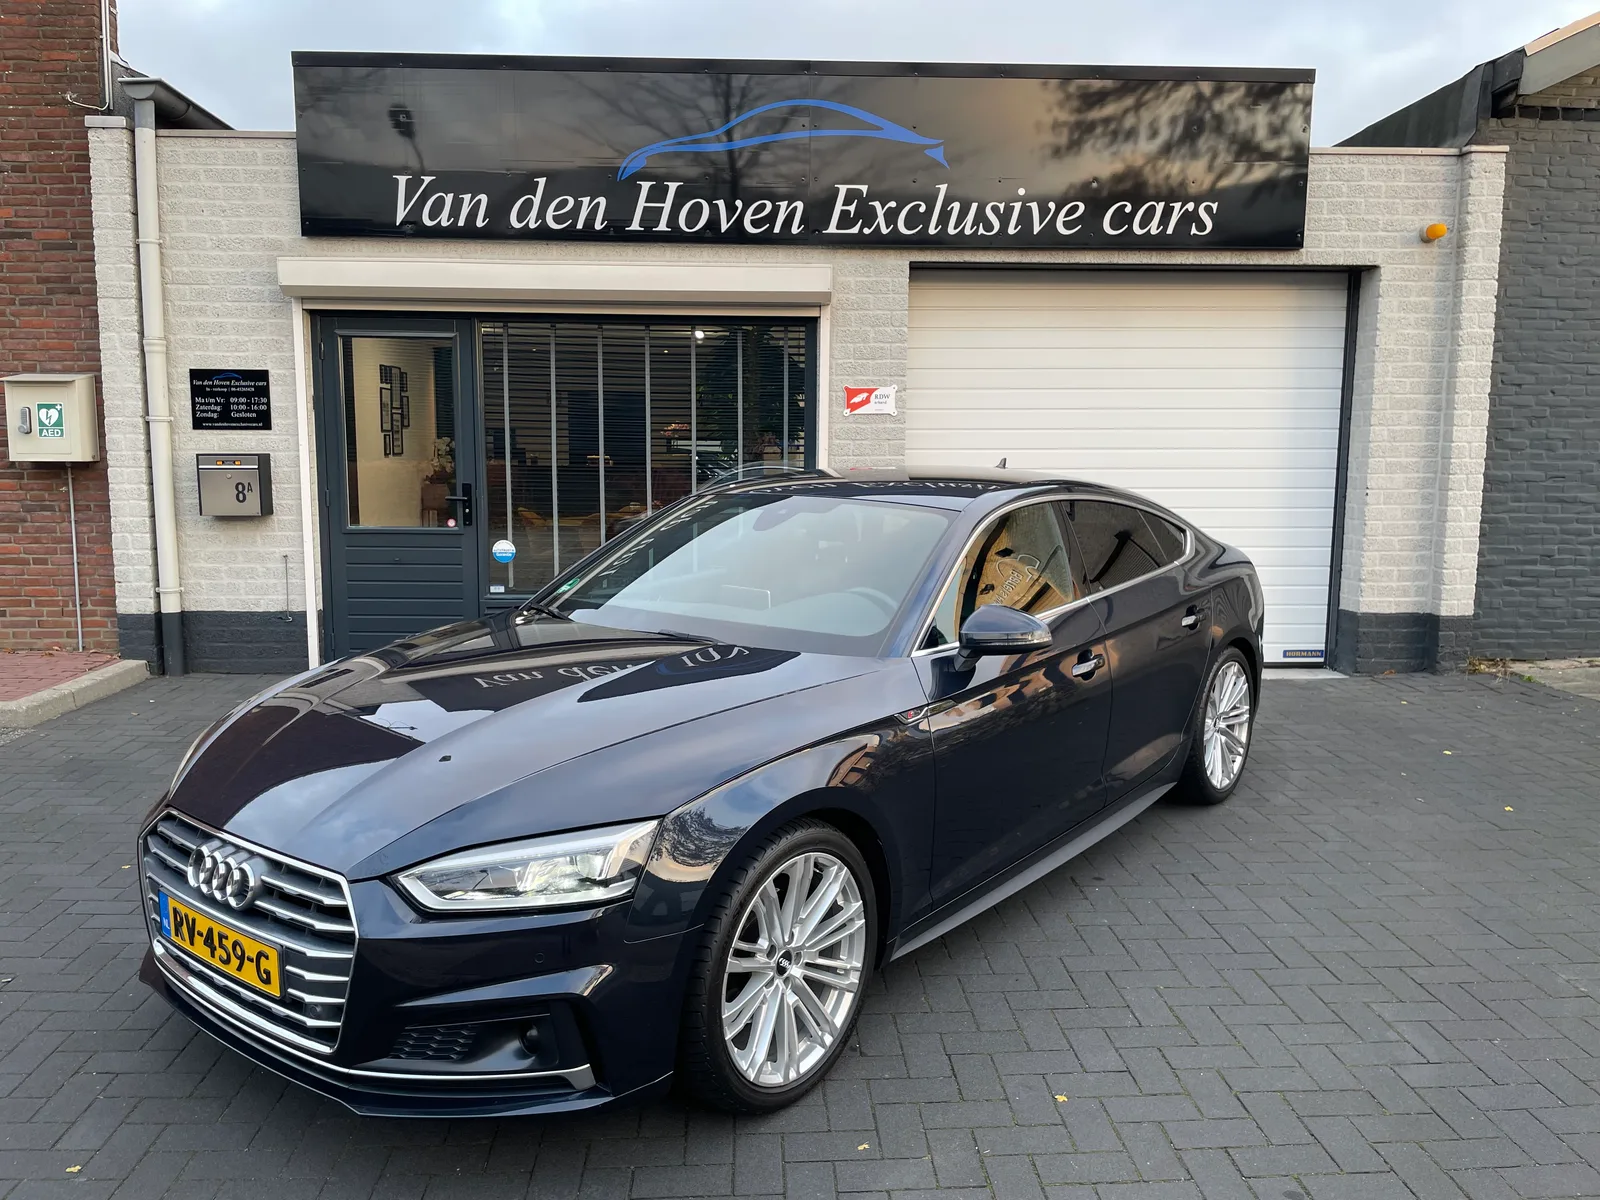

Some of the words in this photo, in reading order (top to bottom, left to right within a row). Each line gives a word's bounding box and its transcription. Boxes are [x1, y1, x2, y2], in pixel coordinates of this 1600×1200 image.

[392, 175, 489, 228] Van
[509, 177, 607, 230] den
[625, 181, 805, 235] Hoven
[823, 184, 1085, 236] Exclusive
[1103, 200, 1219, 236] cars
[195, 404, 223, 412] Zaterdag:
[42, 429, 61, 437] AED
[163, 917, 171, 930] NL
[172, 906, 272, 985] RV-459-G
